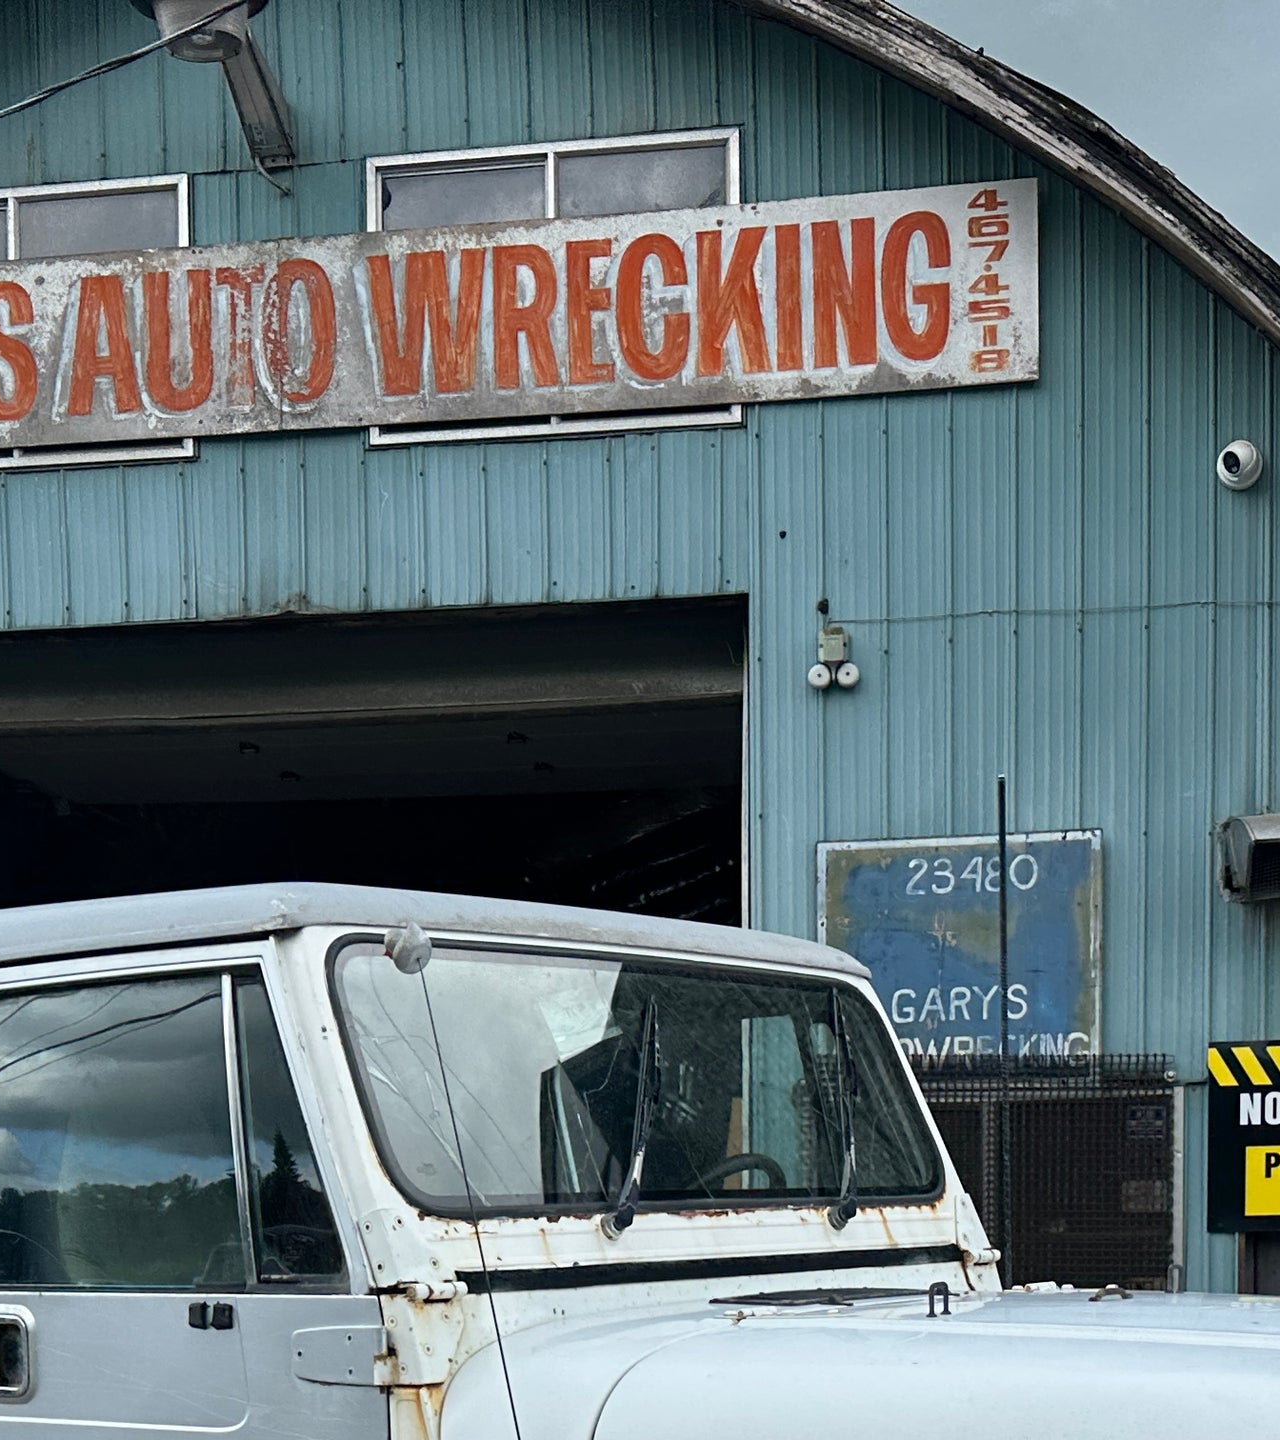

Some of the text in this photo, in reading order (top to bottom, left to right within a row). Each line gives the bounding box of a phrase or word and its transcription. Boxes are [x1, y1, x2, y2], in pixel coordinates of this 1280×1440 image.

[67, 258, 337, 416] AUTO
[366, 210, 951, 397] WRECKING
[906, 854, 1039, 895] 23480
